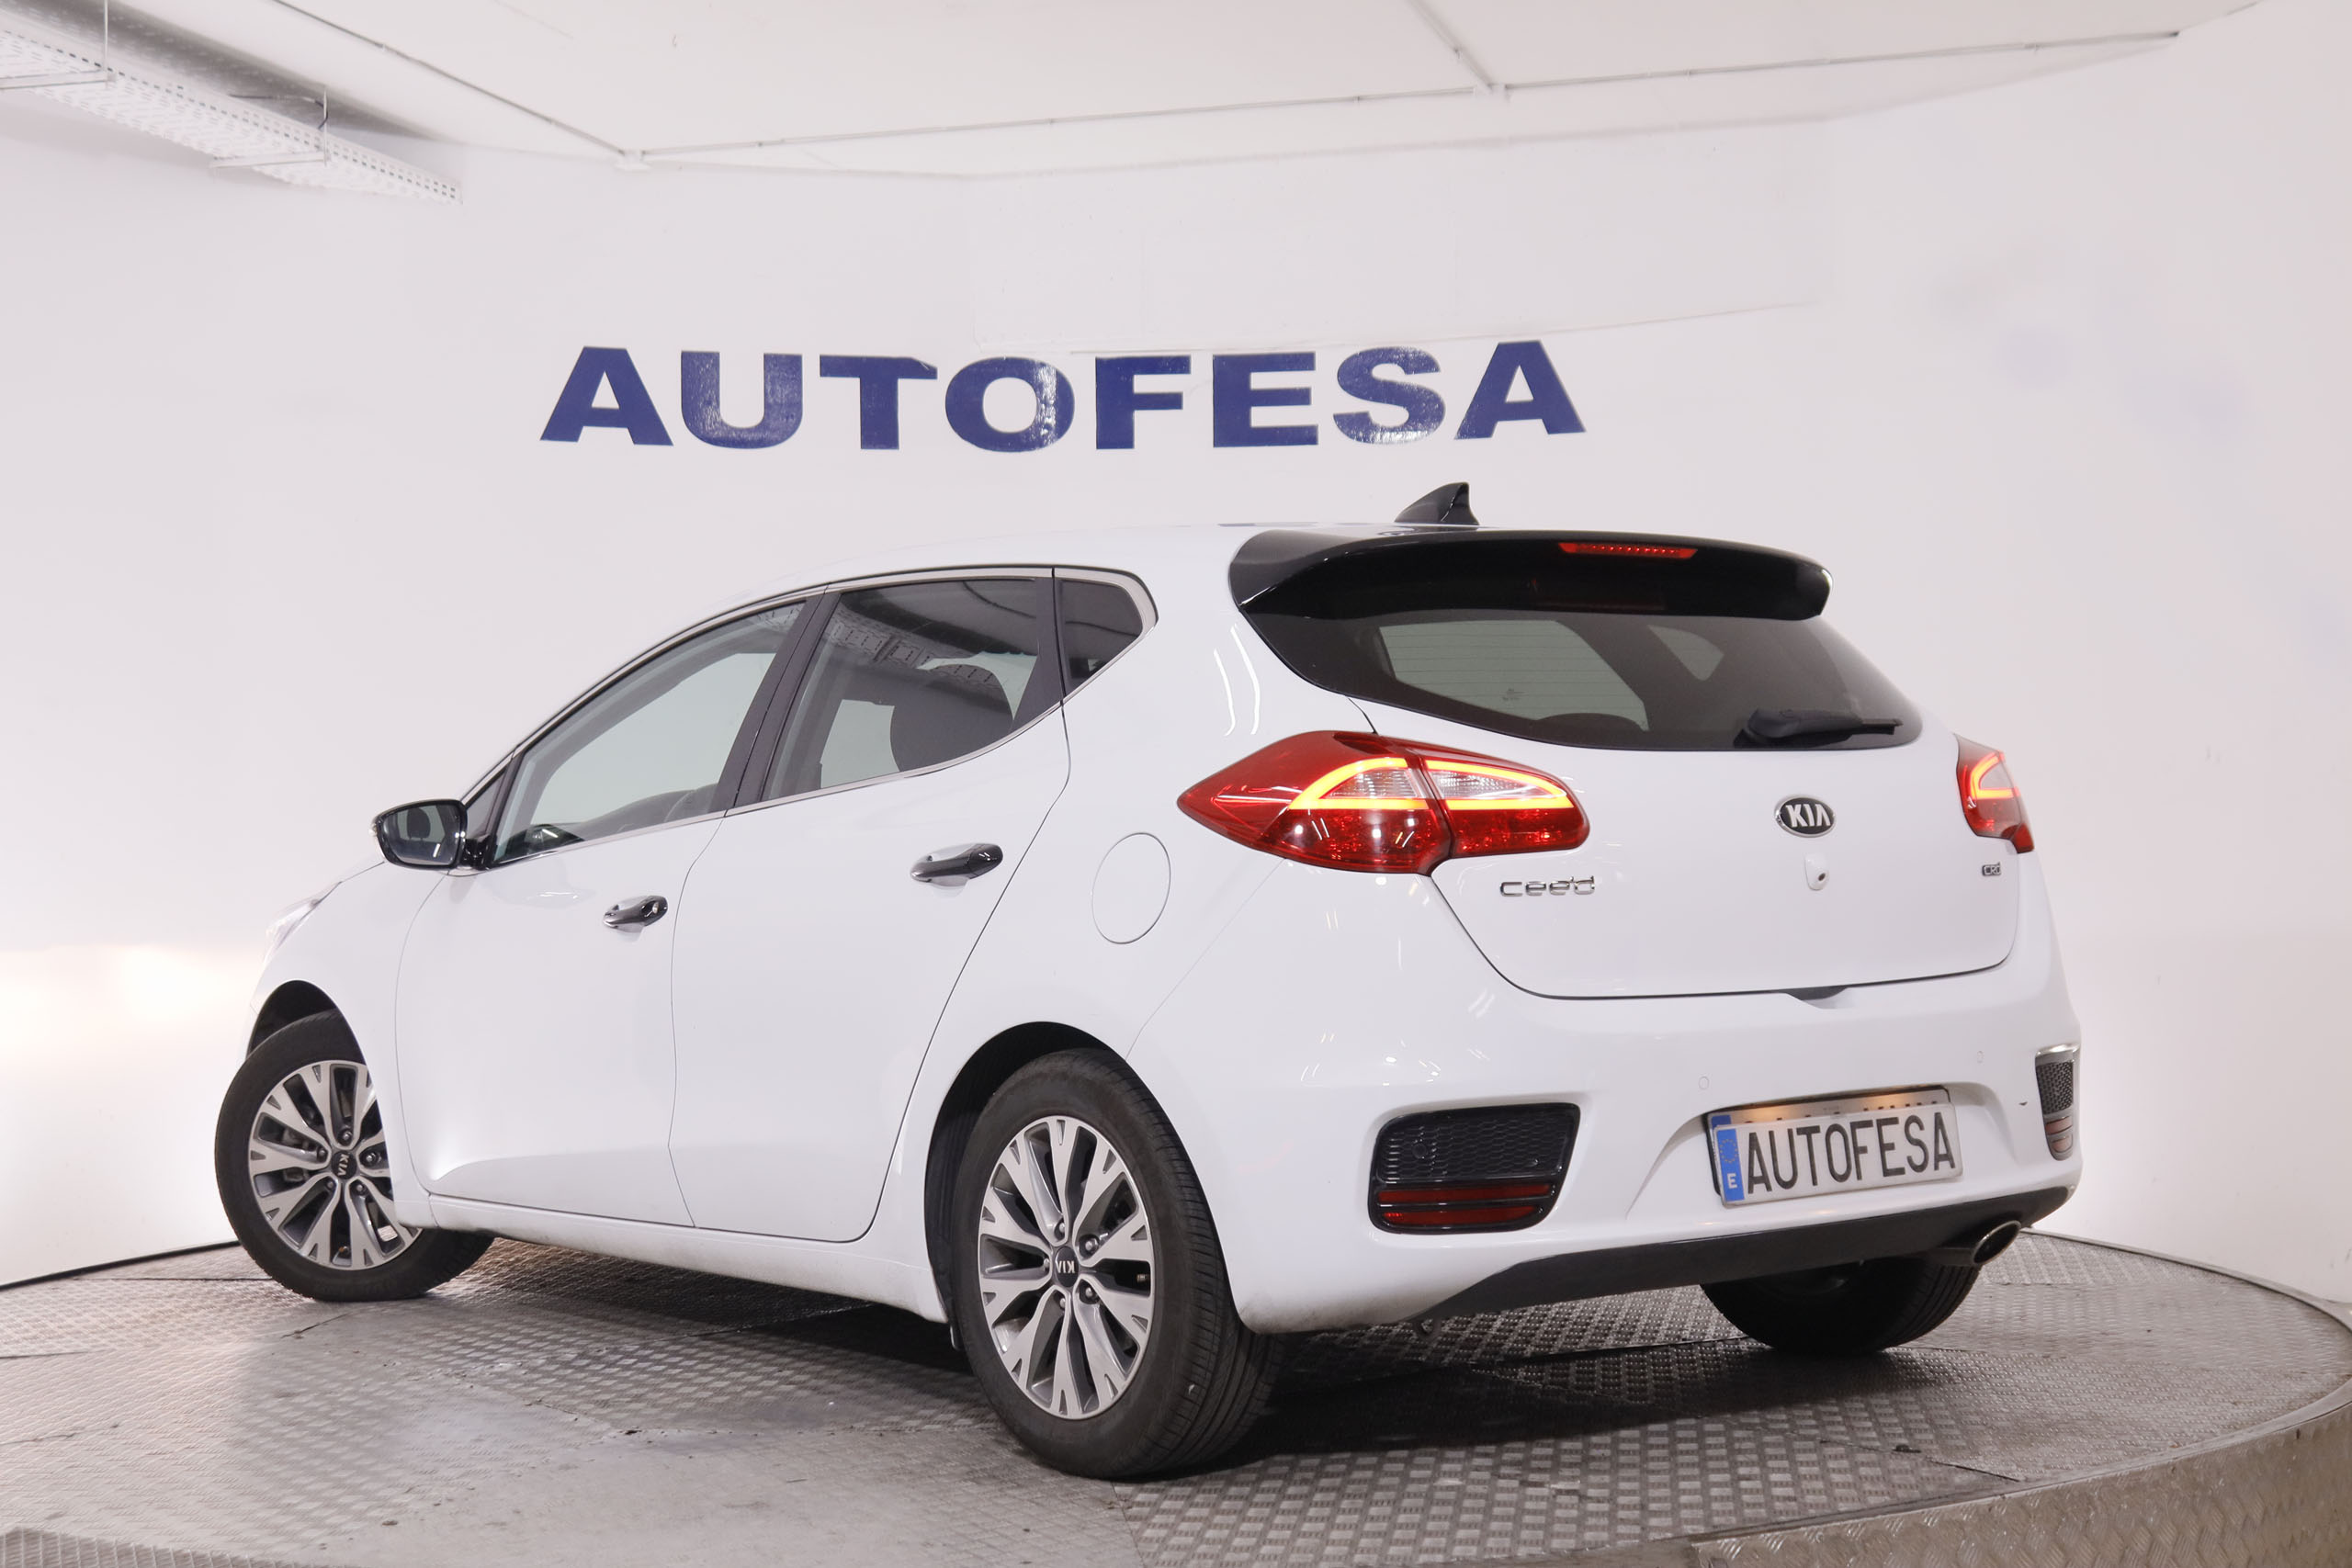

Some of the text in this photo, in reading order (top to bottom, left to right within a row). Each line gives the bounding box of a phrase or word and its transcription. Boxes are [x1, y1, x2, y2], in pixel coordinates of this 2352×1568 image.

[539, 340, 1587, 453] AUTOFESA
[1785, 803, 1831, 828] KIA
[337, 1153, 350, 1176] KIA
[1747, 1111, 1956, 1194] AUTOFESA
[1726, 1172, 1738, 1190] E
[1057, 1260, 1075, 1274] KIA
